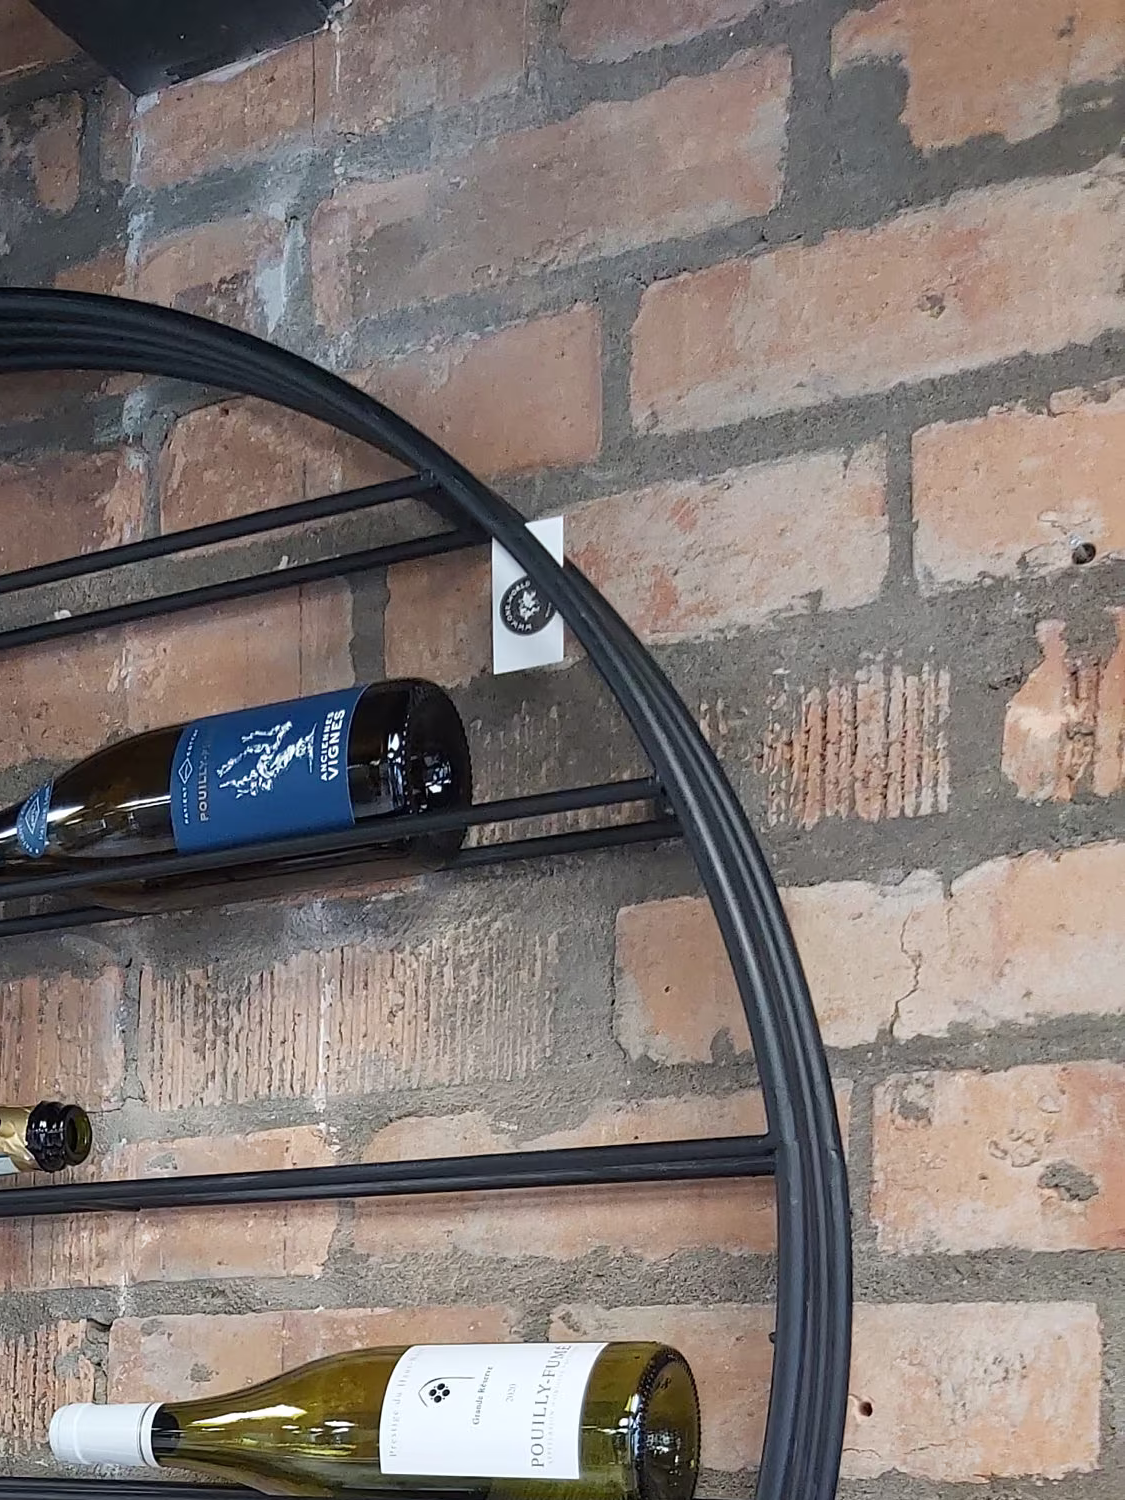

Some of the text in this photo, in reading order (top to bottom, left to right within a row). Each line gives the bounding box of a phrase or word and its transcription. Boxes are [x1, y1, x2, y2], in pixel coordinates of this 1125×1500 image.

[320, 711, 334, 781] ANCIENNES
[328, 709, 346, 781] VIGNES
[472, 1396, 484, 1425] Grande
